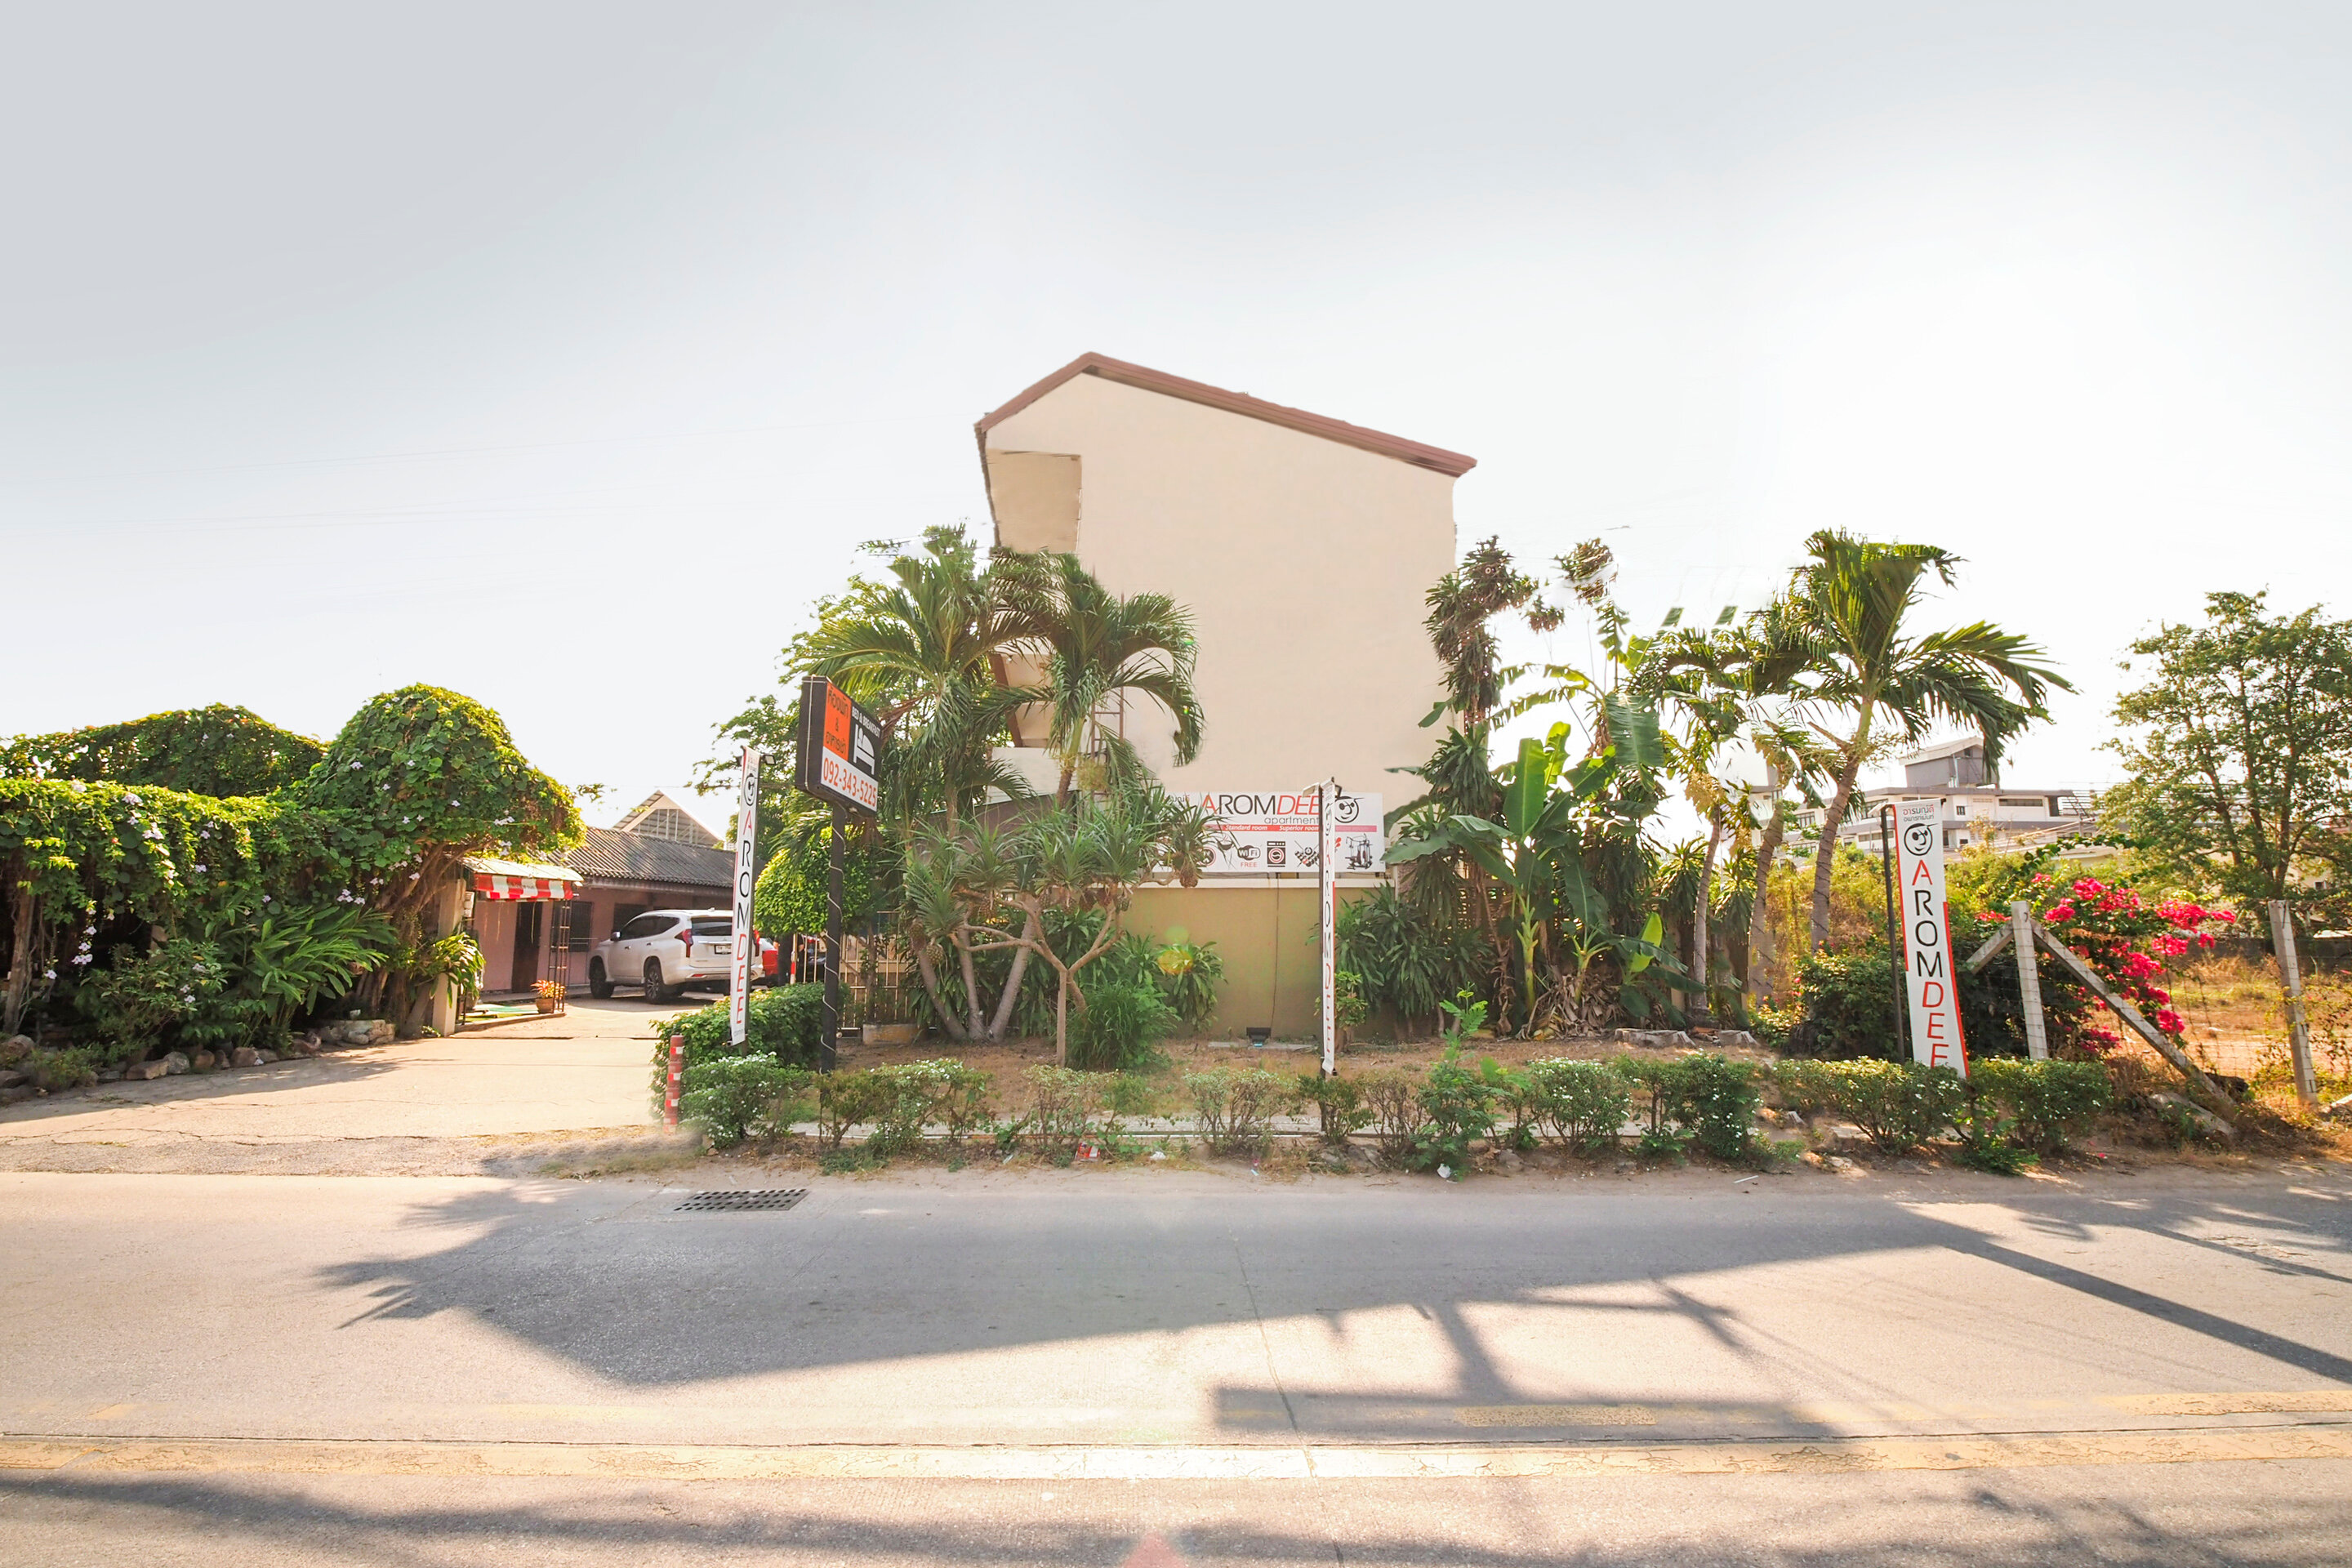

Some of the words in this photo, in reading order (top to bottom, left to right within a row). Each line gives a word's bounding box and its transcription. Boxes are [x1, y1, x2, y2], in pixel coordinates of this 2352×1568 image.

[852, 706, 860, 720] BED
[823, 757, 877, 808] 092-343-5225
[1202, 794, 1324, 815] AROMDEE
[1264, 816, 1320, 826] apartment
